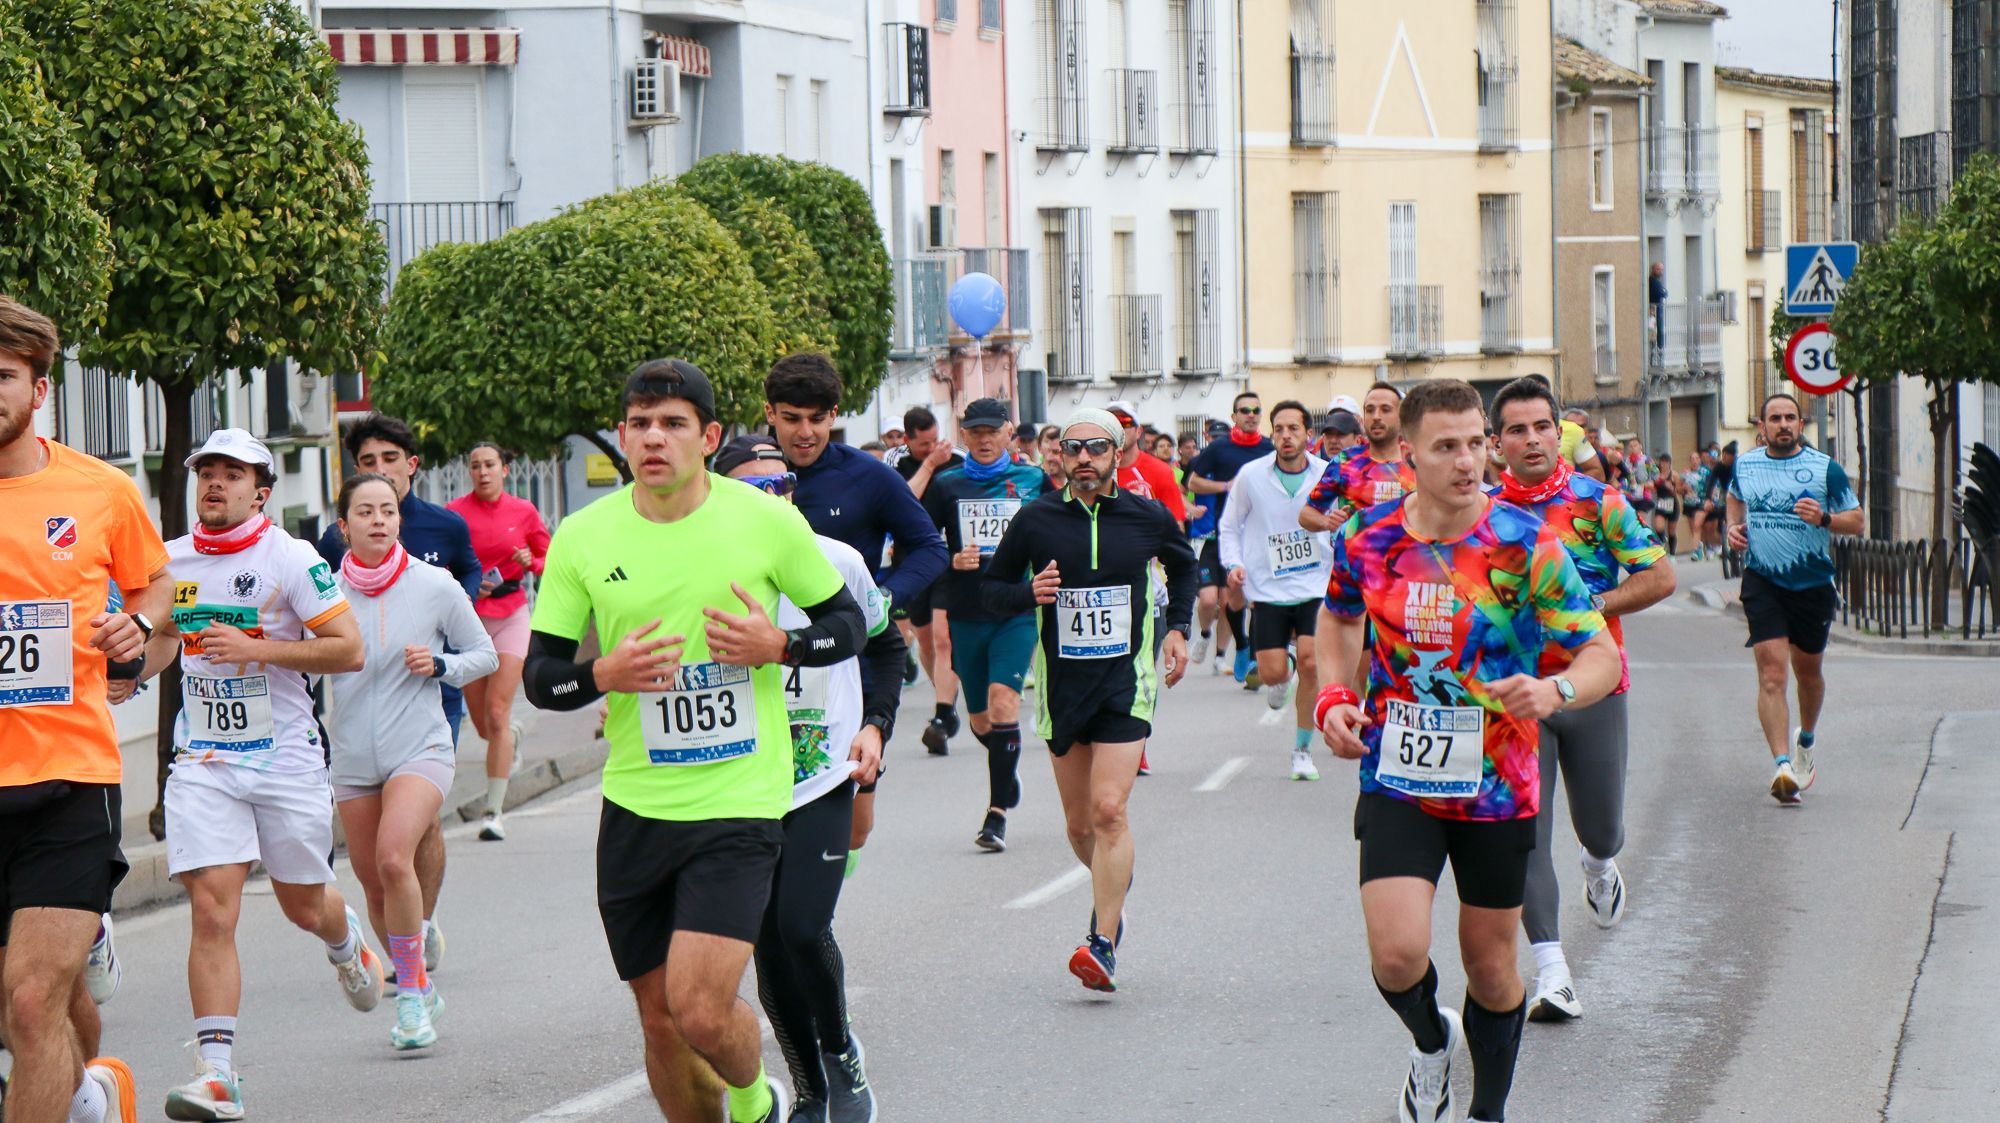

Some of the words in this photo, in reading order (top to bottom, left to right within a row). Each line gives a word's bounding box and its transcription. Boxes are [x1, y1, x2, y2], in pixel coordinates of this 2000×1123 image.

[1764, 521, 1807, 531] RUNNING
[52, 552, 74, 560] CCM
[1276, 541, 1312, 562] 1309
[1405, 581, 1438, 606] XII
[172, 611, 245, 625] ARRERA
[1405, 605, 1436, 619] MEDIA
[1072, 610, 1112, 636] 415
[1405, 618, 1453, 634] MARATÓN
[0, 633, 40, 675] 26
[552, 680, 579, 696] KIPRUN
[202, 701, 248, 732] 789
[656, 690, 737, 734] 1053
[1400, 731, 1454, 768] 527
